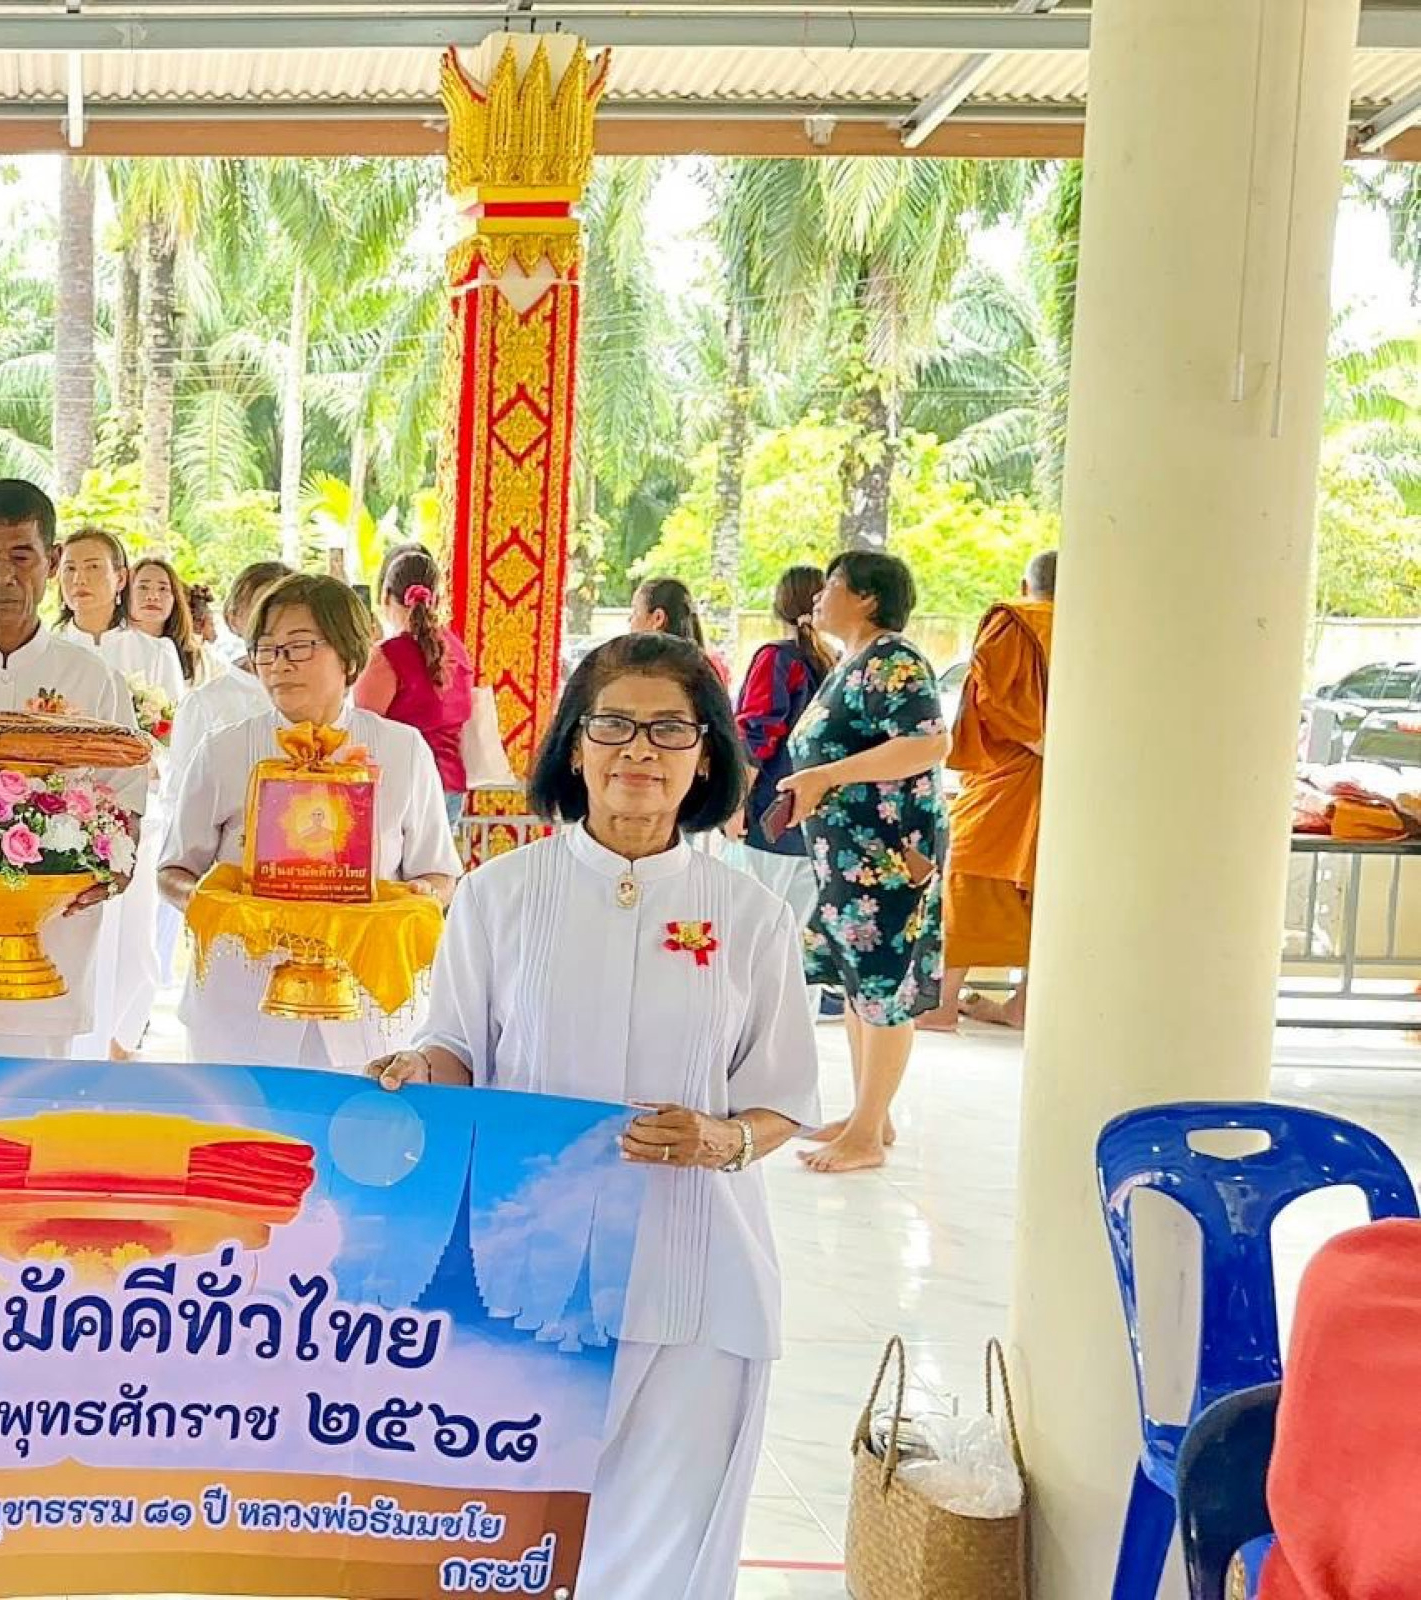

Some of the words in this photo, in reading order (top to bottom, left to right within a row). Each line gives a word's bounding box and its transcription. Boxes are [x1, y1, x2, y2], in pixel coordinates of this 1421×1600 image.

[306, 1392, 542, 1463] ๒๕๖๘
[144, 1501, 192, 1526] ๘๑
[204, 1487, 229, 1526] ปี
[238, 1495, 502, 1539] หลวงพ่อธัมมชโย
[443, 1537, 552, 1591] กระบี่
